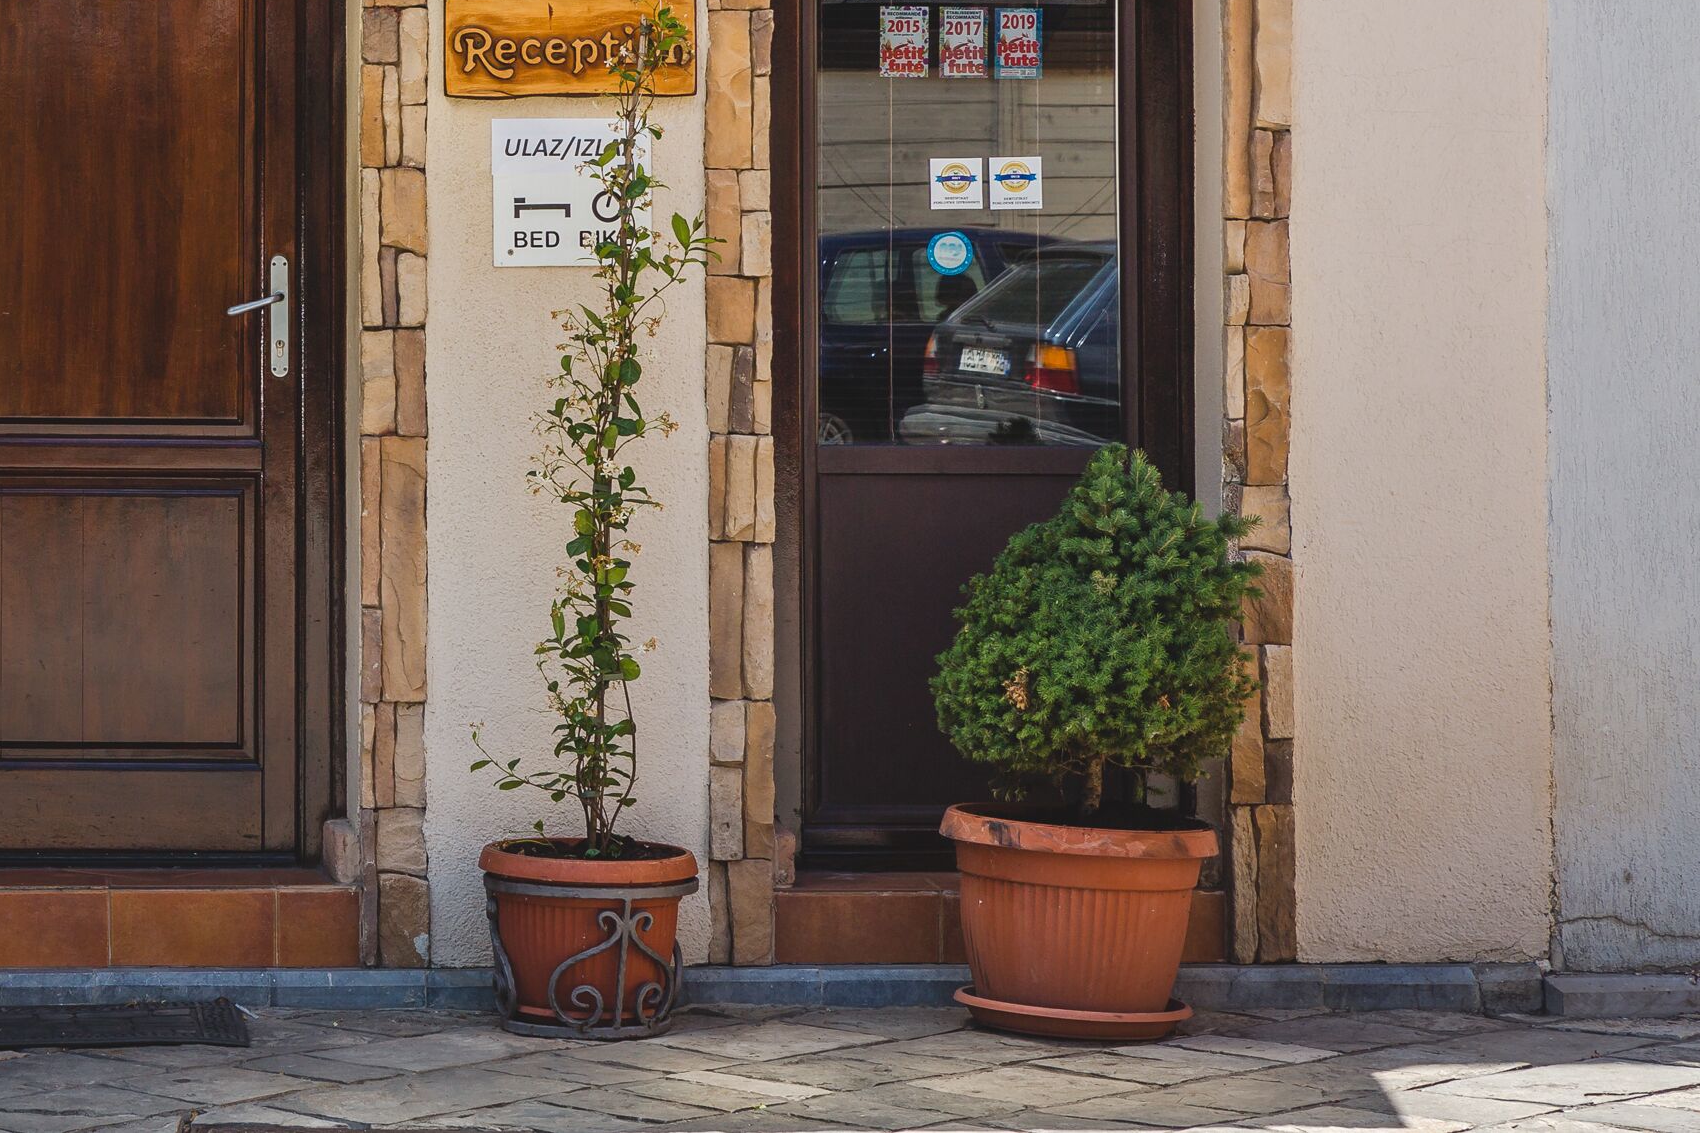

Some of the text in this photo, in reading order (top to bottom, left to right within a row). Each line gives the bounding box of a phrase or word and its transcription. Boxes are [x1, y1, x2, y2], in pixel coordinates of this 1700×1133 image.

[887, 19, 920, 33] 2015
[945, 21, 982, 34] 2017
[1002, 13, 1036, 29] 2019
[453, 26, 692, 79] Receptin
[881, 46, 925, 63] petit
[940, 46, 985, 64] petit
[997, 39, 1039, 56] petit
[514, 230, 632, 248] BED BIK
